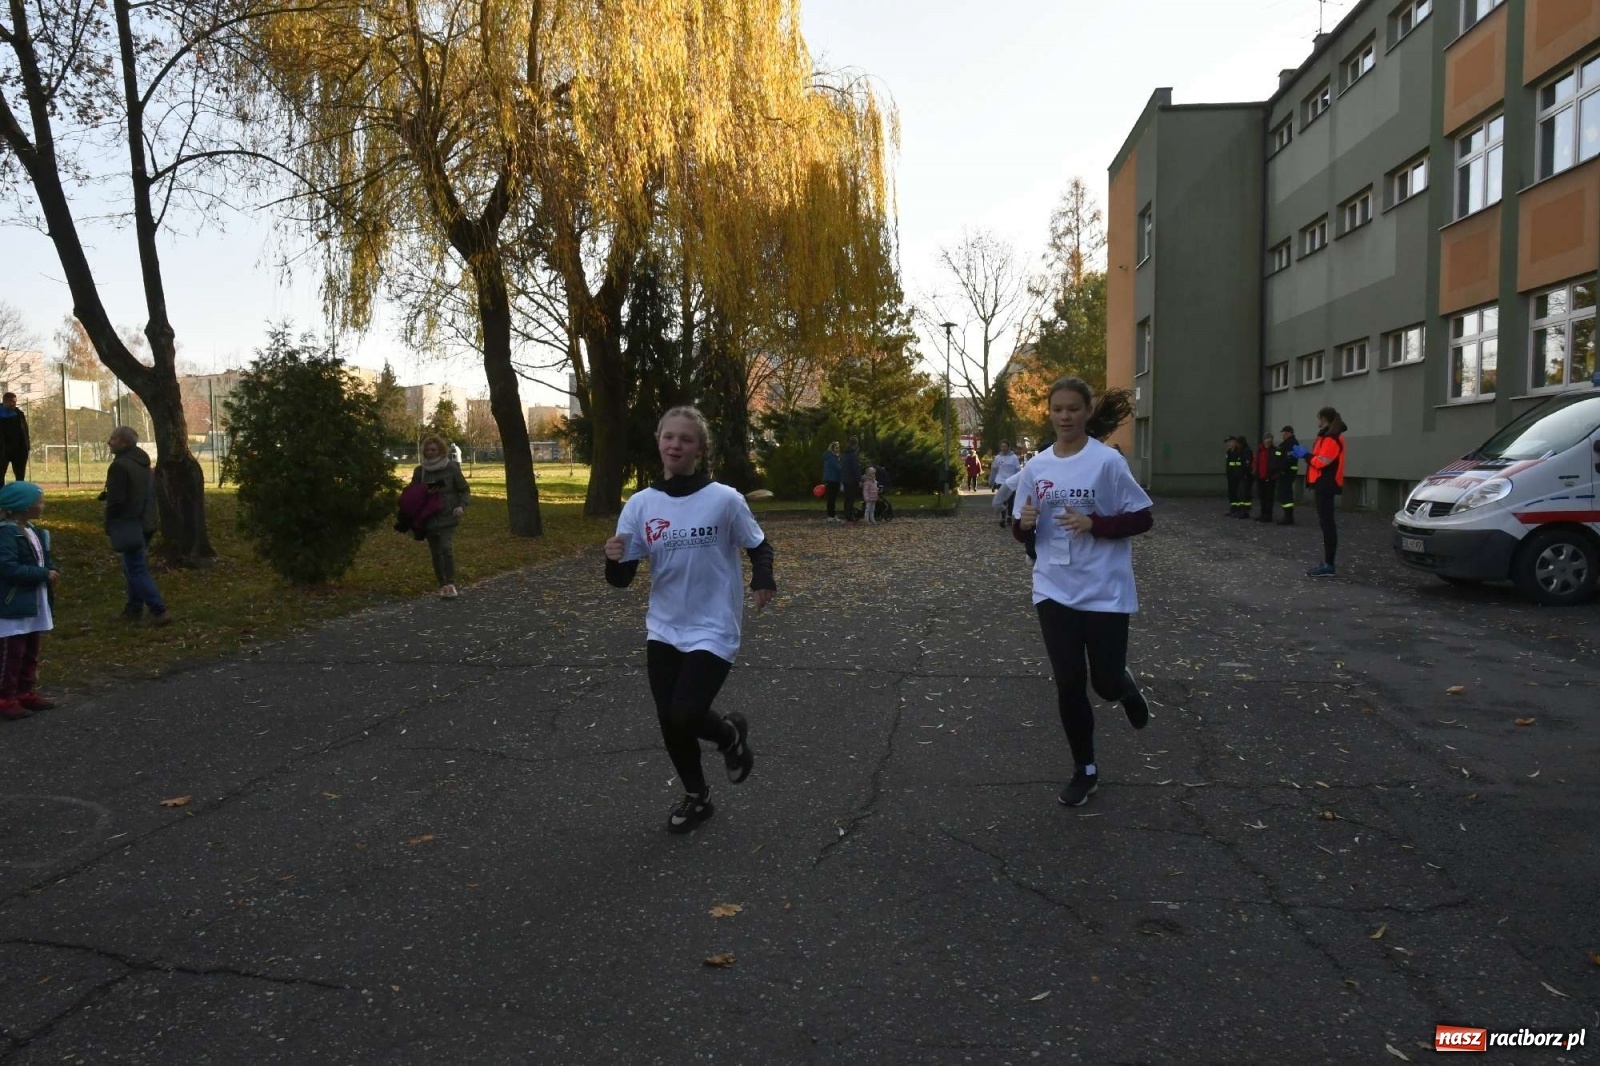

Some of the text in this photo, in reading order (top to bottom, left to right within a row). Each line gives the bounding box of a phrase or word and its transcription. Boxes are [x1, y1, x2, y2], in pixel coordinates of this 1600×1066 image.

[1046, 489, 1096, 500] BIEG 2021
[662, 526, 718, 541] BIEG 2021
